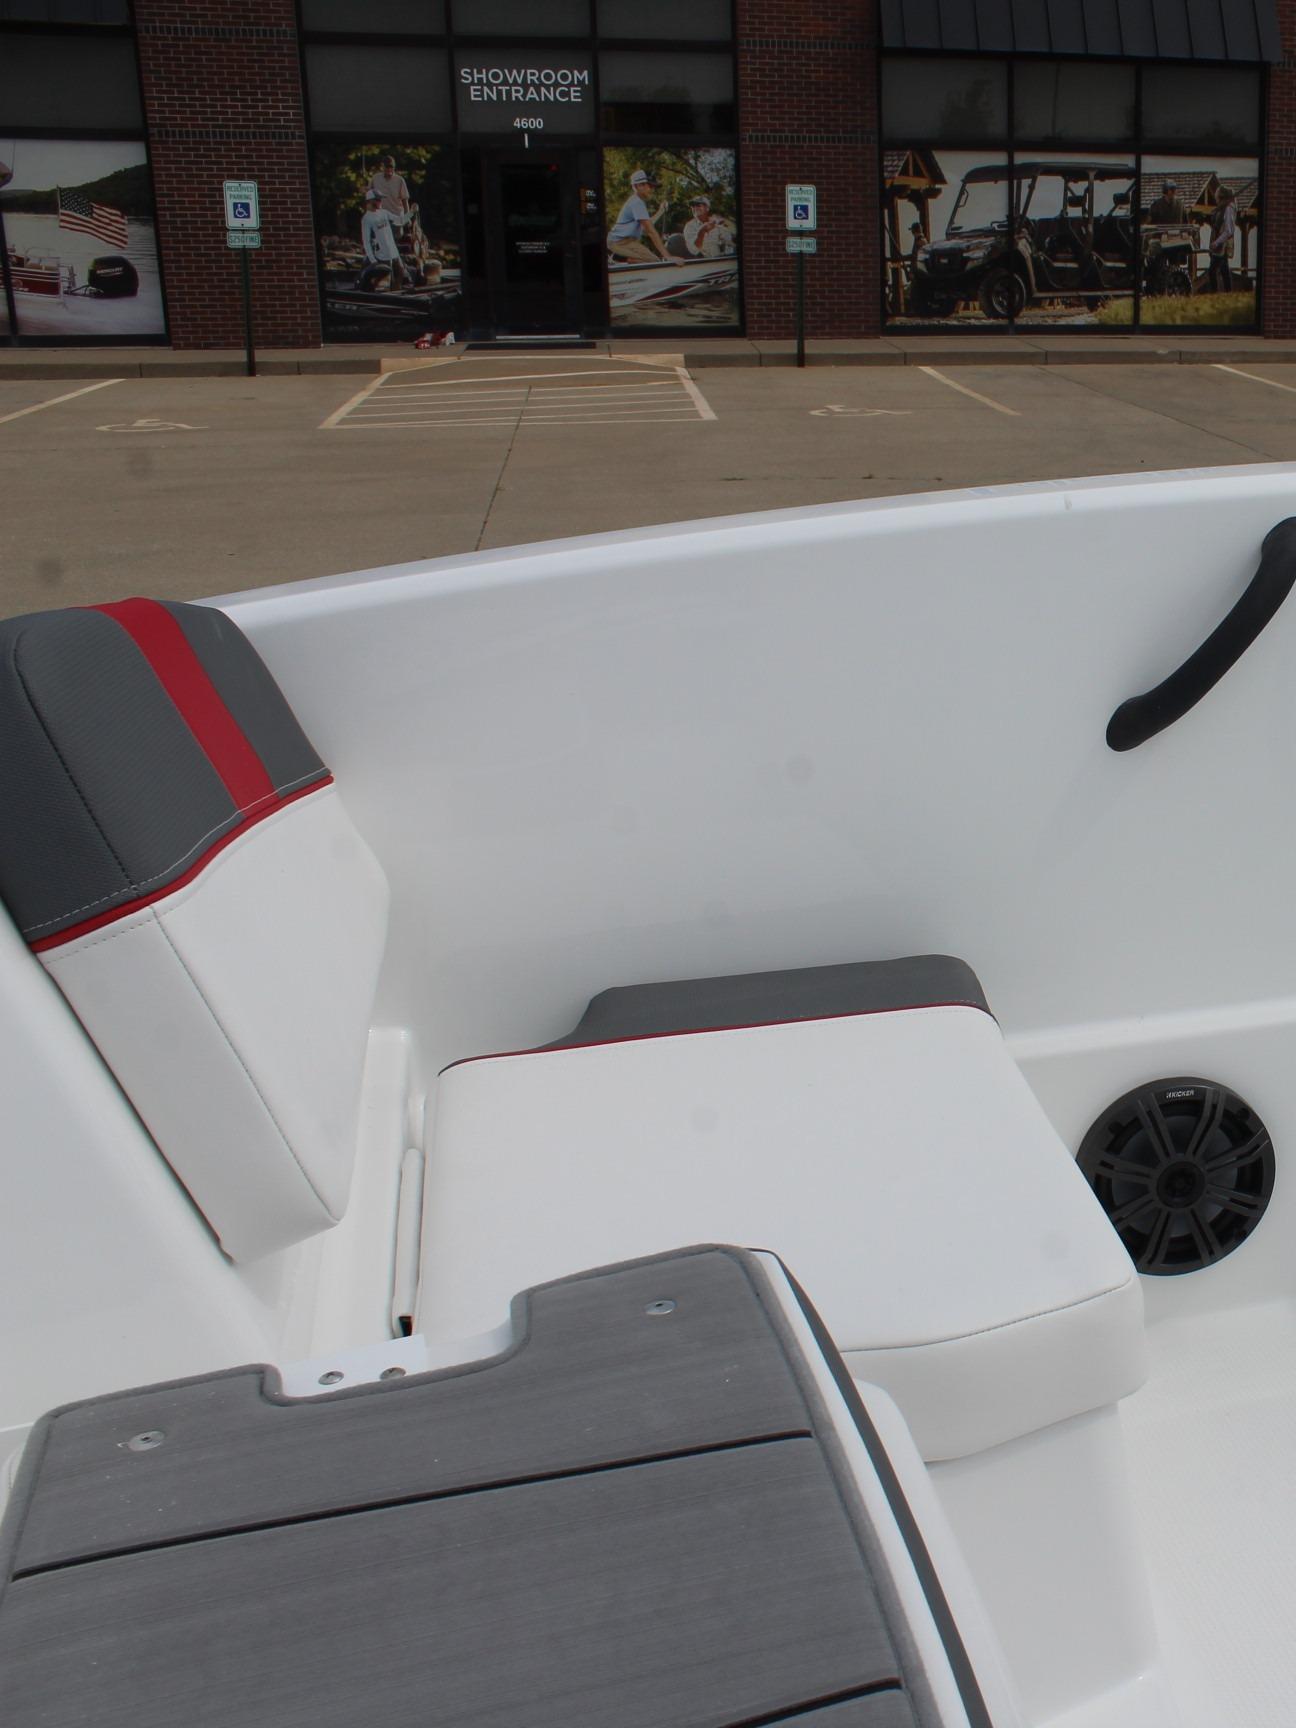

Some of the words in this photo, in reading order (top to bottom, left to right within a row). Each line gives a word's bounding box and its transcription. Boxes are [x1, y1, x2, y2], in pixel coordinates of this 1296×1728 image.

[460, 68, 589, 85] SHOWROOM
[470, 85, 582, 102] ENTRANCE
[513, 117, 544, 129] 4600
[1170, 1090, 1194, 1098] KICKER
